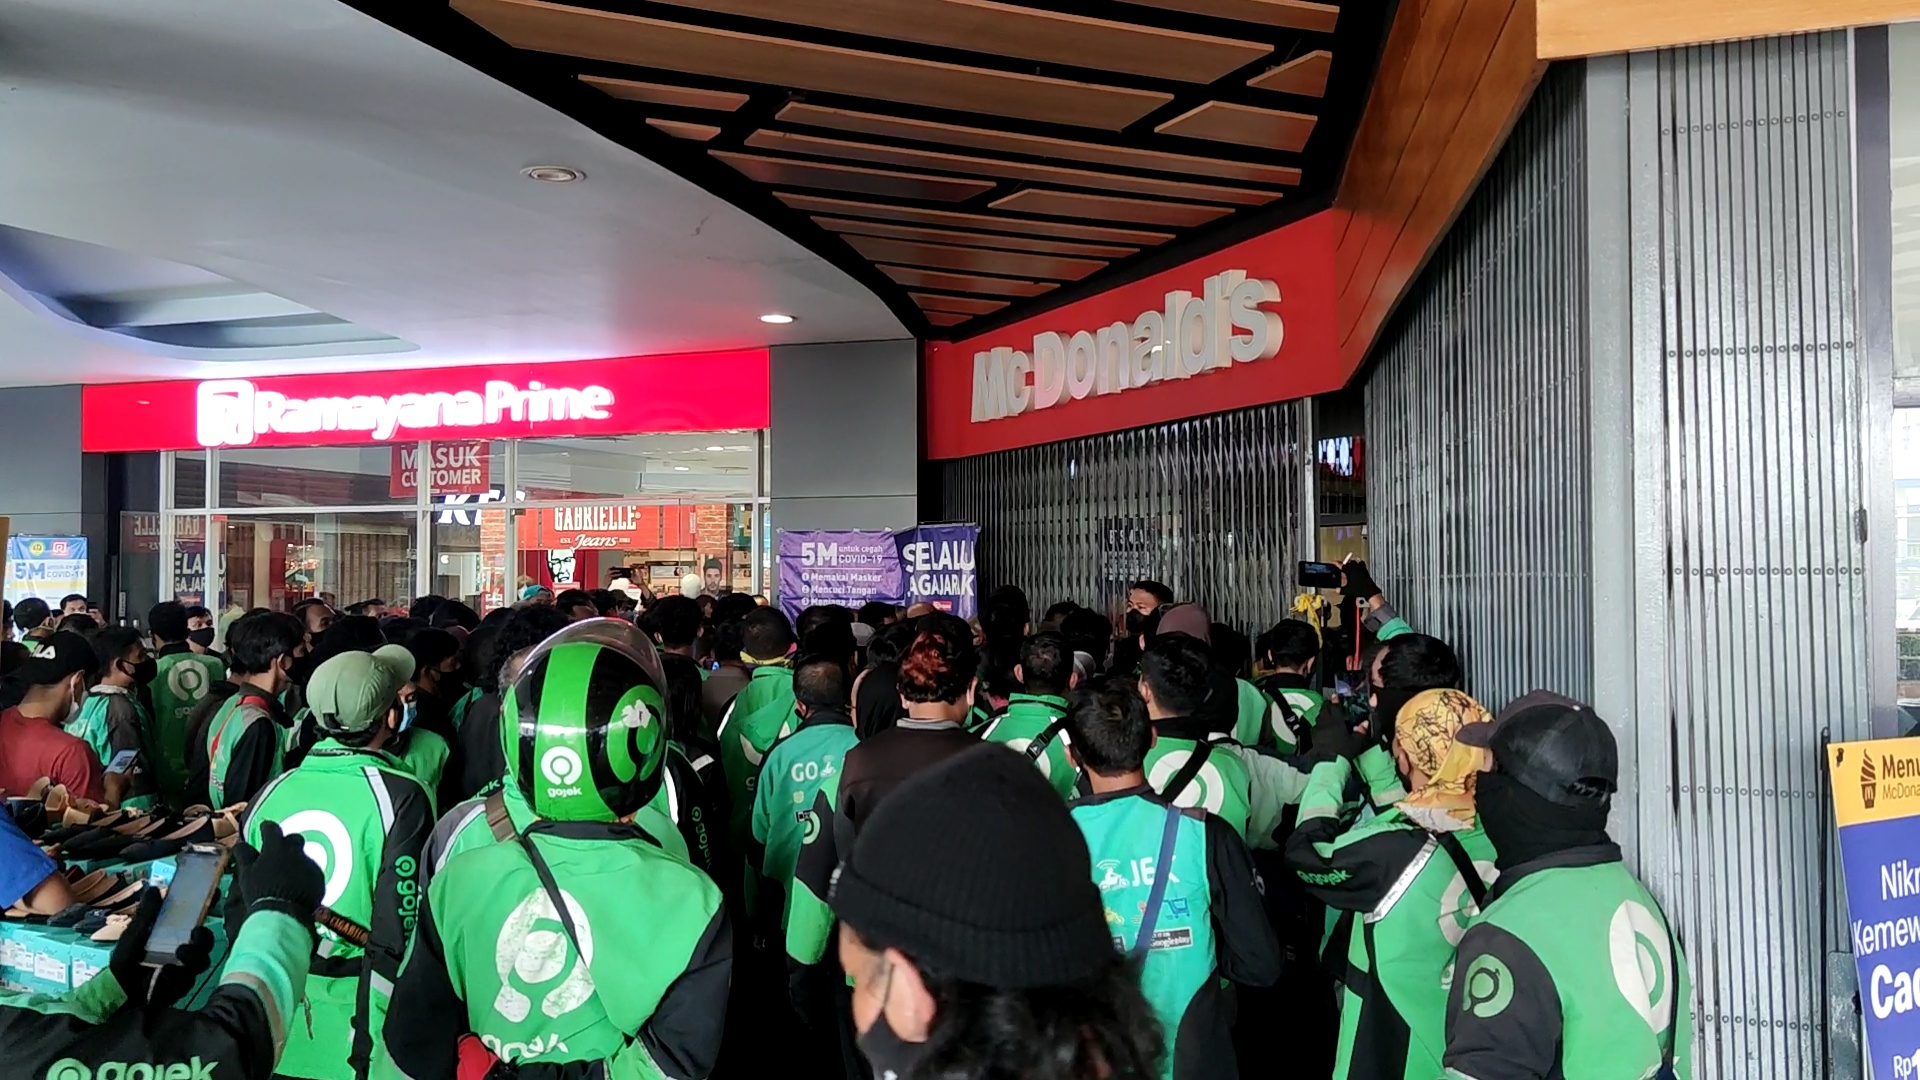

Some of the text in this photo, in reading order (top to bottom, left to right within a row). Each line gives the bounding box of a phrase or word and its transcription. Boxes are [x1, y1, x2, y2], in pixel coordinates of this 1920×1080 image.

[971, 268, 1284, 422] McDonald's
[401, 469, 481, 487] CUTOMER
[569, 534, 619, 550] Jeans
[801, 542, 838, 566] 5M
[839, 554, 882, 564] COVID-19
[902, 540, 976, 573] SELALU
[14, 562, 46, 580] 5M
[850, 573, 882, 582] Masker
[811, 585, 846, 594] Mencuci
[847, 586, 877, 596] Tangan
[791, 761, 818, 782] GO
[547, 786, 582, 798] gojek
